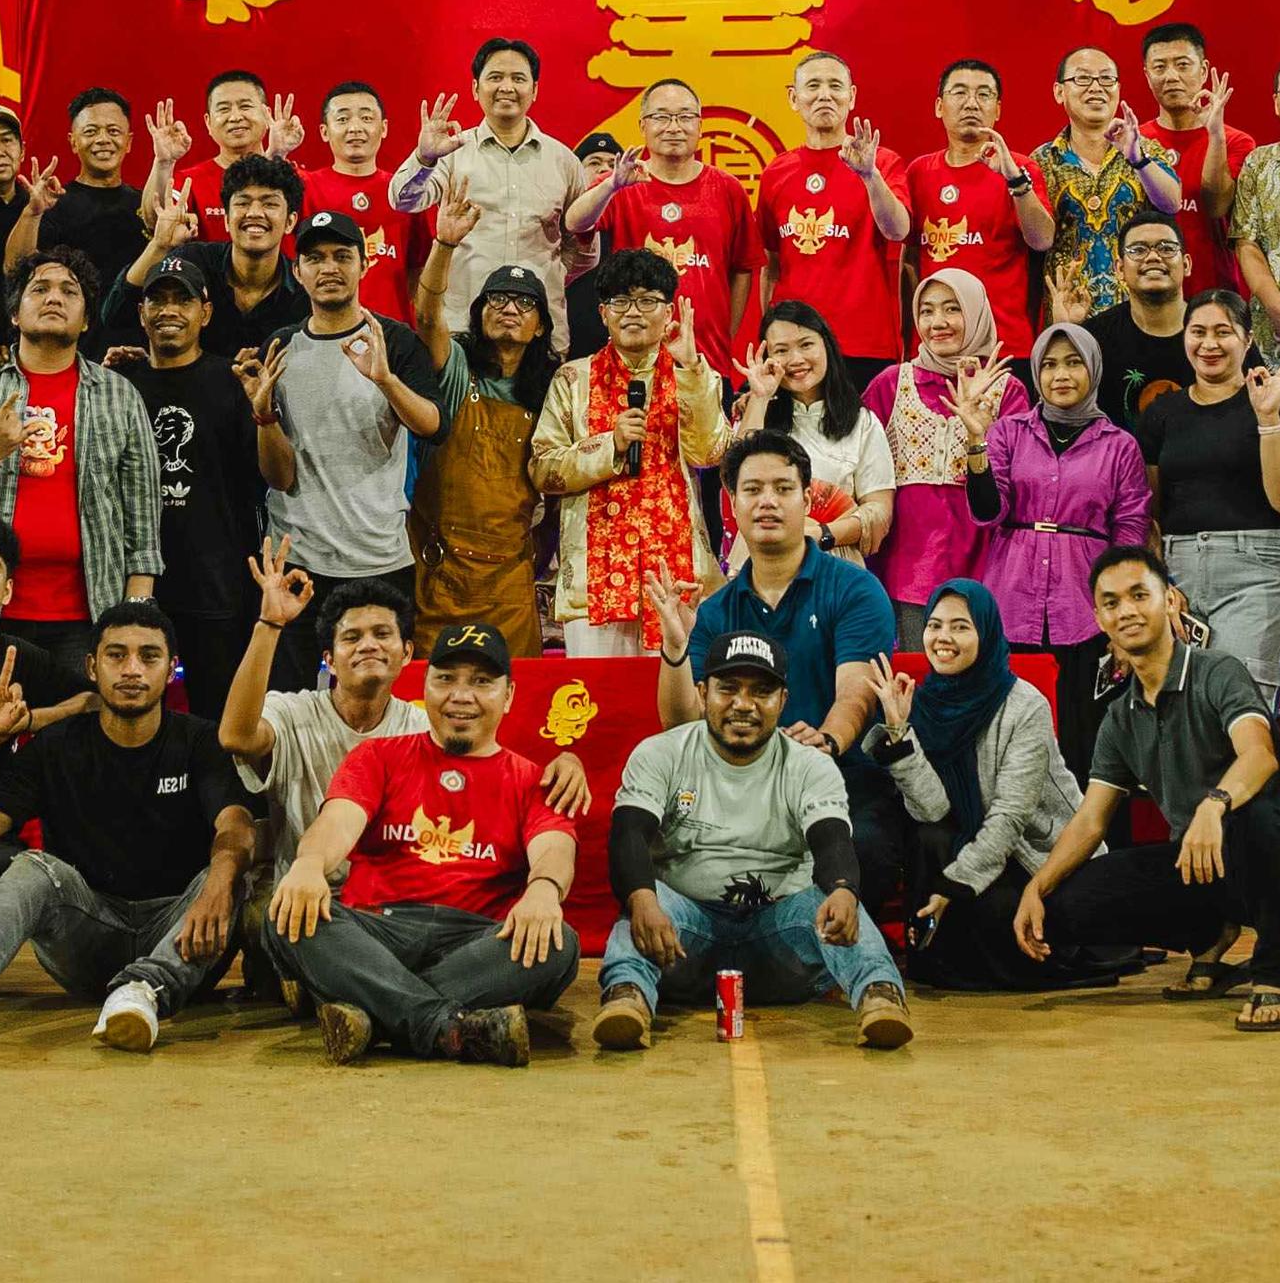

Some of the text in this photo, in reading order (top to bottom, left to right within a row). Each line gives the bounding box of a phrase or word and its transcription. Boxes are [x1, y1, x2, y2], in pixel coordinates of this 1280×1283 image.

[779, 222, 850, 238] INDONESIA
[921, 231, 984, 246] DONESIA
[383, 823, 497, 862] INDONESIA
